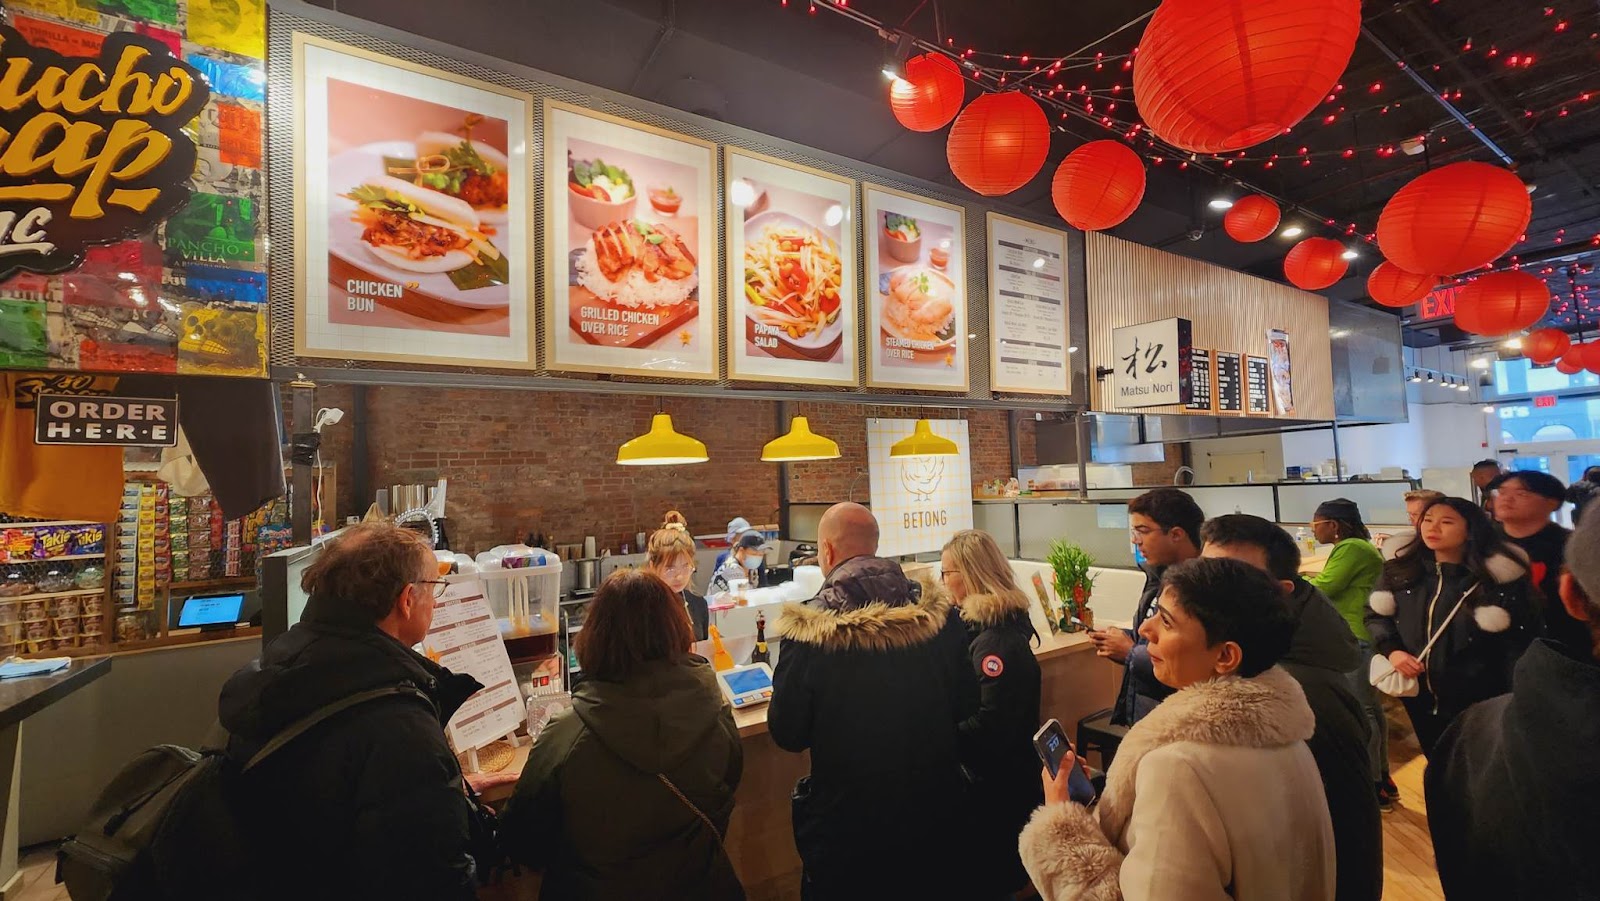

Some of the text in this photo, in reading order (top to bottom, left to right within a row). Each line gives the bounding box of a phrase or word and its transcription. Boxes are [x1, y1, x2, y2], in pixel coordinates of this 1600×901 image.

[167, 237, 240, 255] PANCHO
[181, 249, 227, 264] VILLA
[346, 279, 403, 299] CHICKEN
[347, 296, 375, 313] BUN
[580, 306, 660, 326] GRILLED CHICKEN
[581, 320, 629, 337] OVER RICE
[754, 323, 780, 336] PAPAYA
[754, 336, 778, 349] SALAD
[885, 337, 910, 348] STEAMED
[886, 348, 915, 360] OVER RICE
[1121, 336, 1168, 380] 松
[1121, 381, 1173, 397] Matsu Nori
[49, 401, 167, 421] ORDER
[903, 509, 947, 529] BETONG
